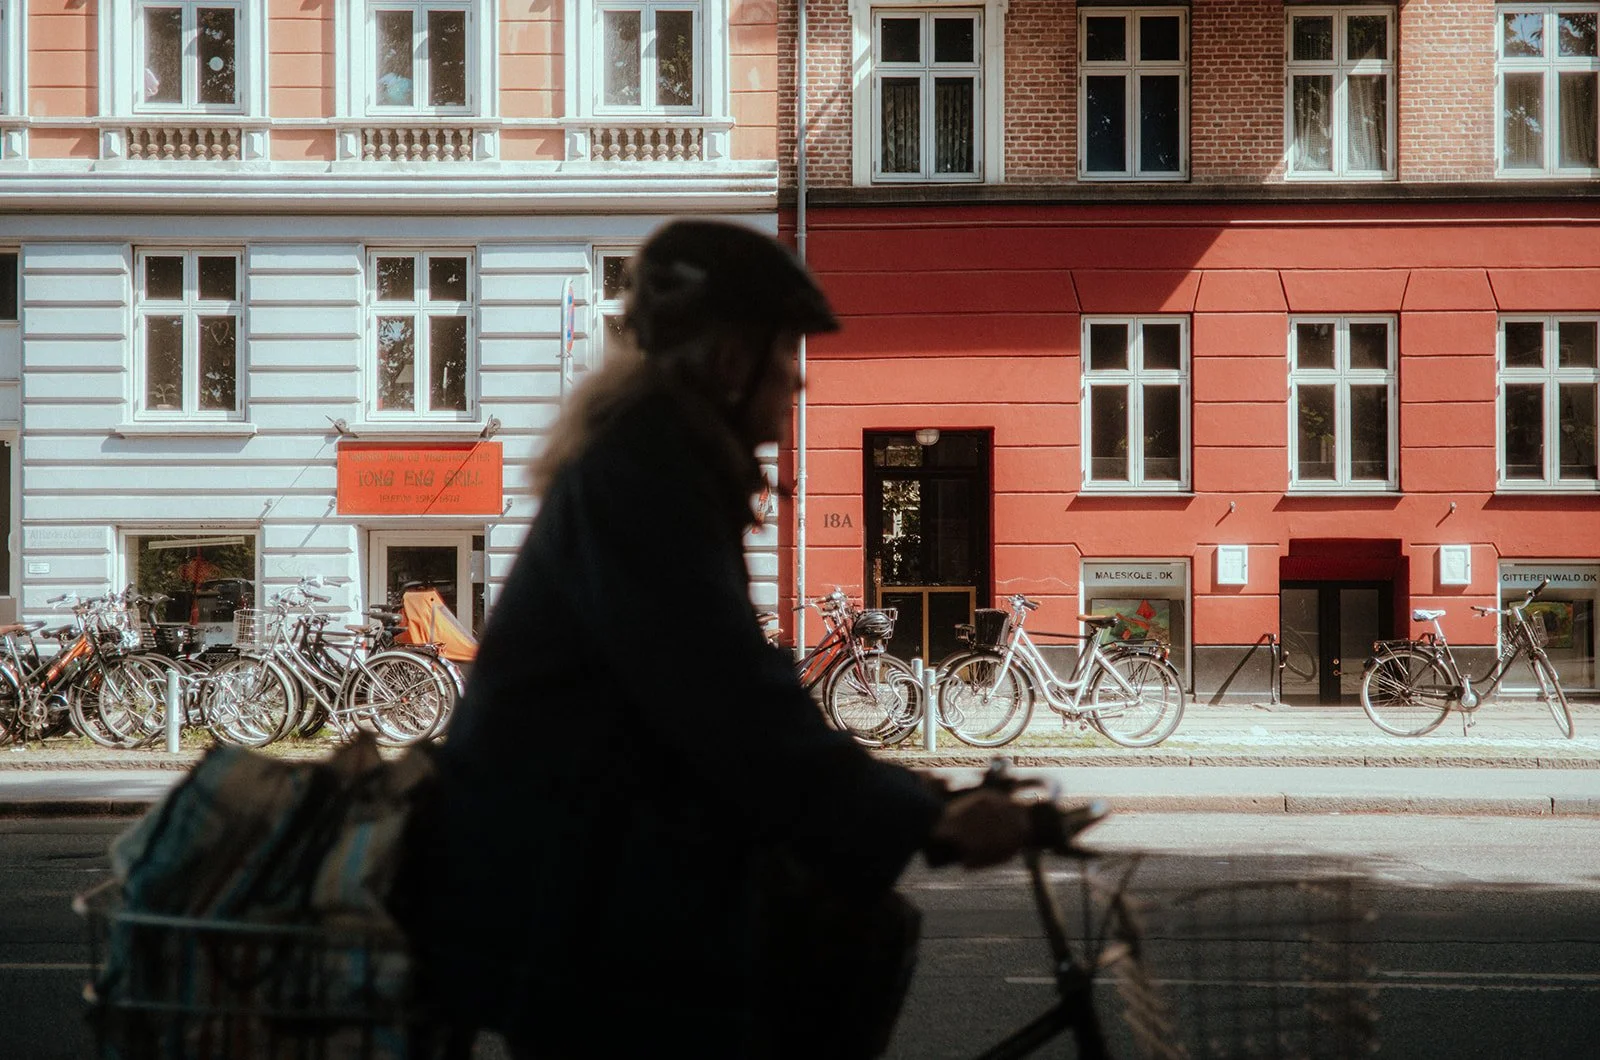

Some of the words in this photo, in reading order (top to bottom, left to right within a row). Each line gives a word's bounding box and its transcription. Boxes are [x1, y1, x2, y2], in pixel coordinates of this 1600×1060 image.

[357, 470, 395, 487] TONG
[404, 470, 435, 487] ENG
[444, 470, 483, 487] GRILL
[823, 513, 853, 528] 18A
[1502, 573, 1597, 582] GITTEREINWALD.DK
